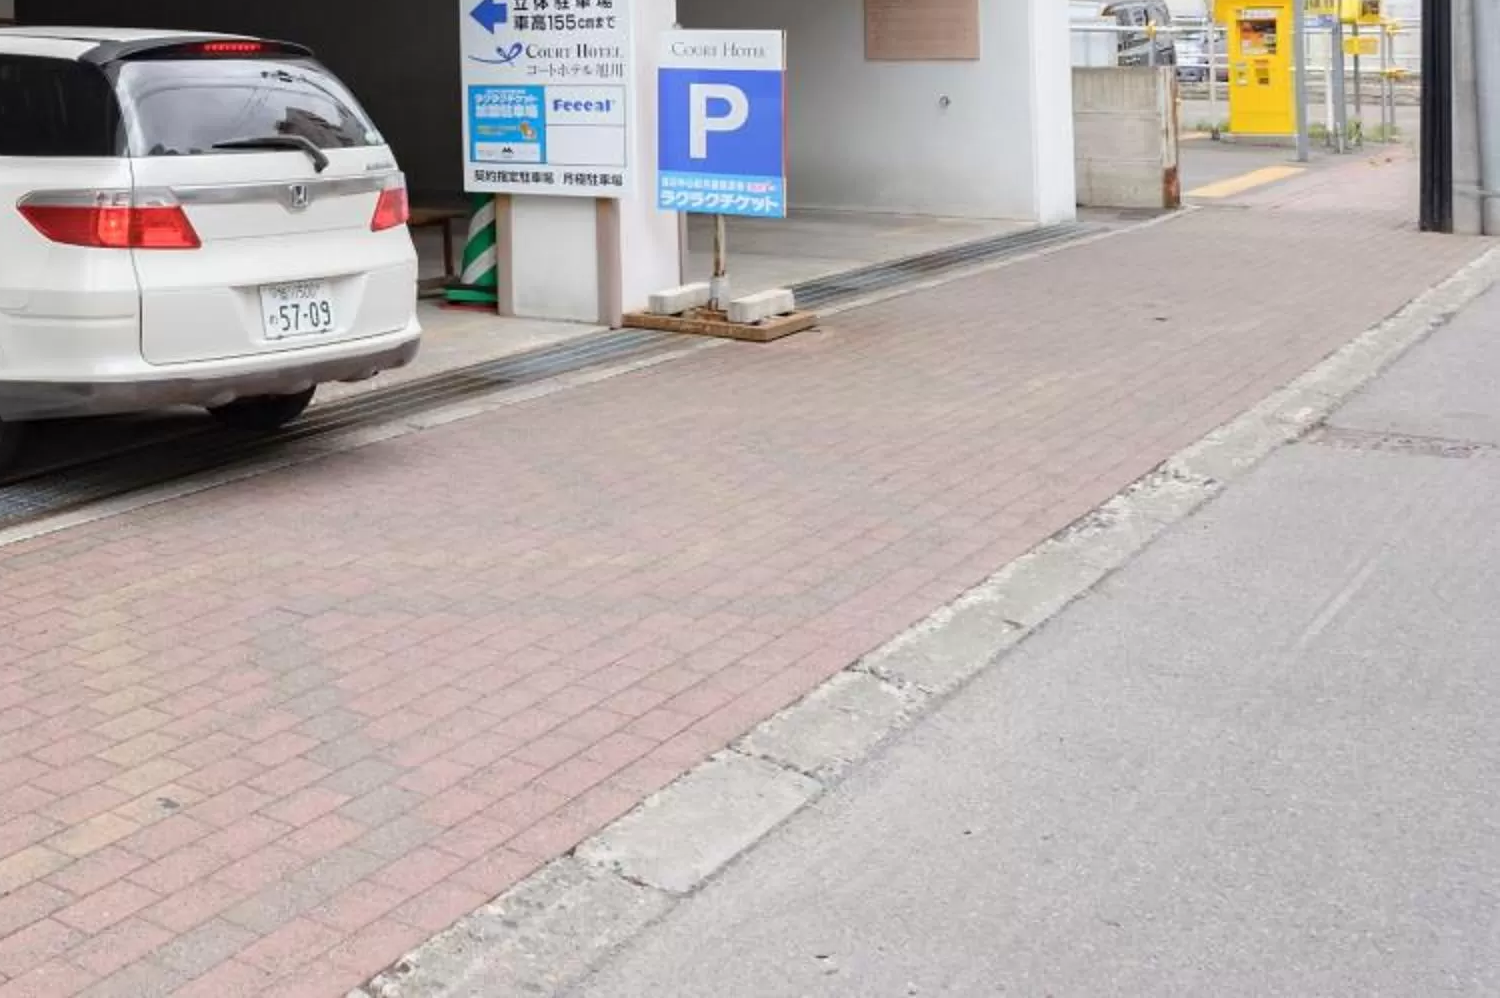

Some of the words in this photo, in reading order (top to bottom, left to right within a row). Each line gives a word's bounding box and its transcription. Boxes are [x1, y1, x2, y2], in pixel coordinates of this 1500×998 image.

[513, 14, 616, 31] 車高155cmまで
[689, 83, 749, 159] P
[562, 172, 623, 187] 月極駐車場
[660, 189, 779, 212] ラクラクチケット
[279, 300, 332, 331] 57-09
